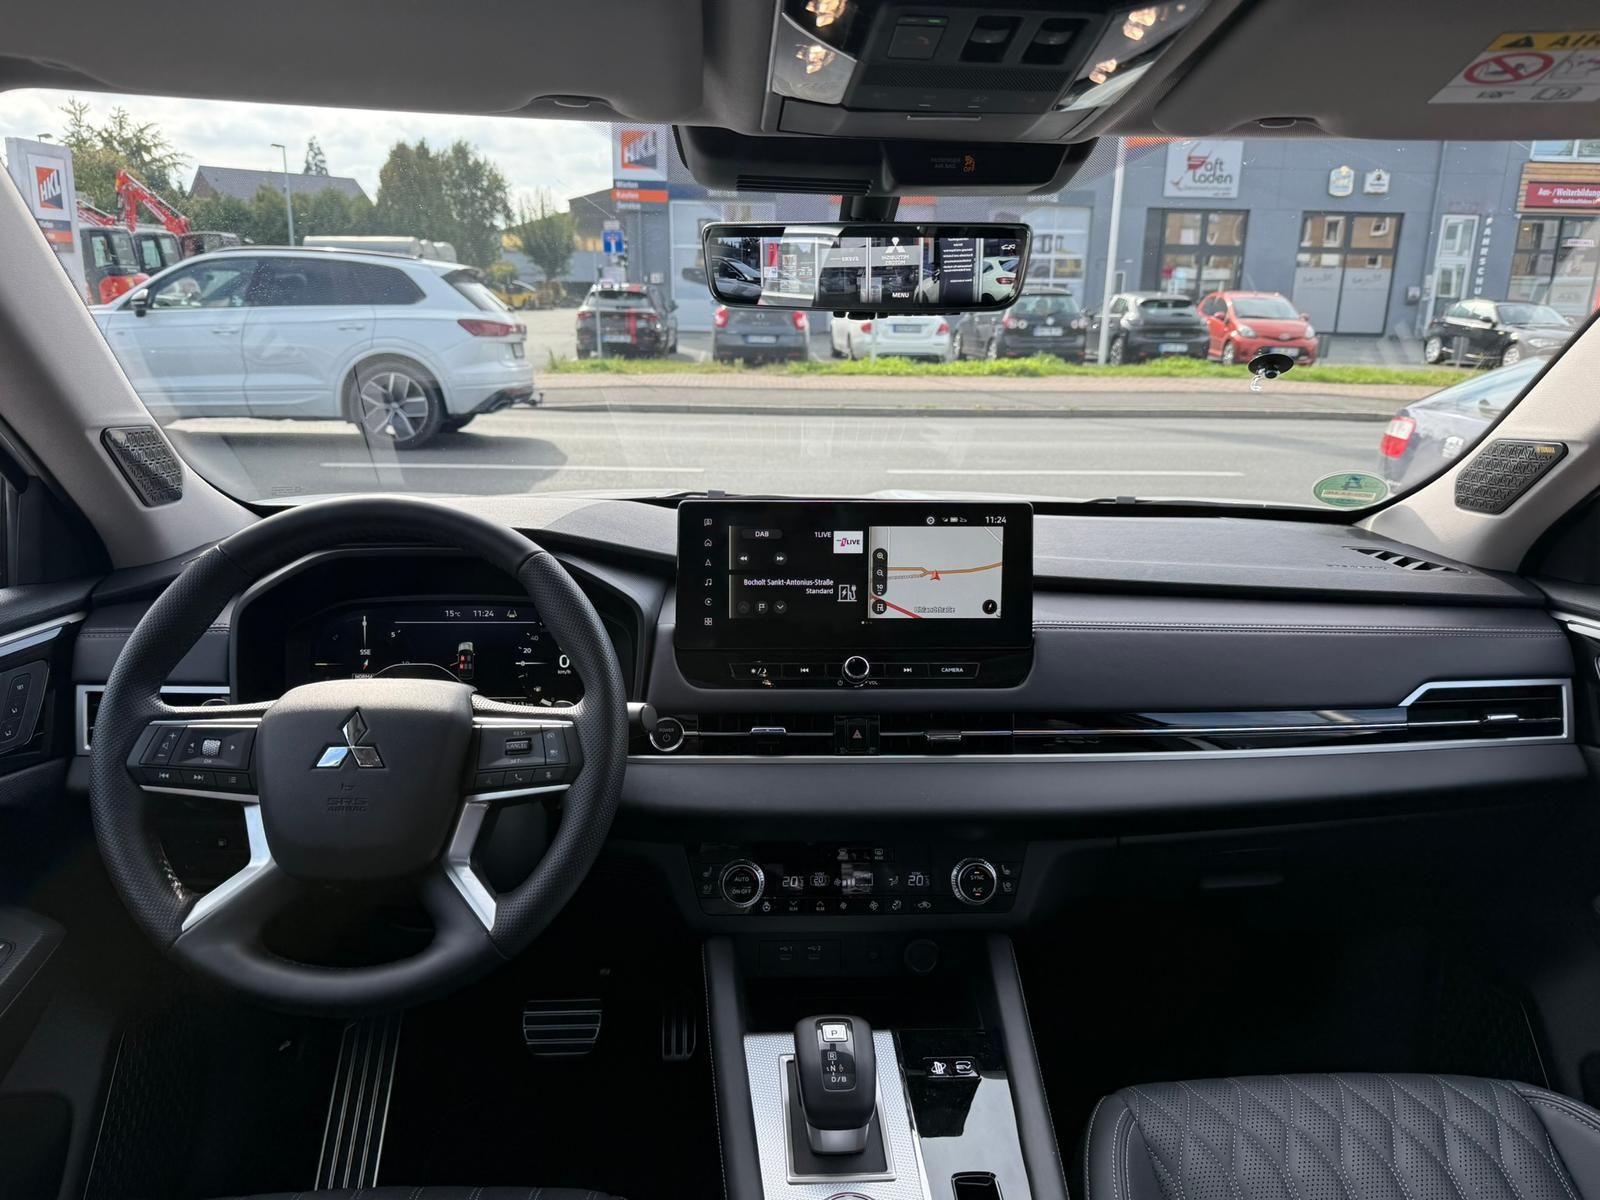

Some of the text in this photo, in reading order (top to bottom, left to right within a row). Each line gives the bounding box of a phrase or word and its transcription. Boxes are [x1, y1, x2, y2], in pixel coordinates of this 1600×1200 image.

[39, 168, 61, 202] HKL
[985, 516, 1007, 524] 11:24
[743, 578, 834, 586] Bocholt Sankt-Antonius-Straße
[559, 654, 570, 668] 0
